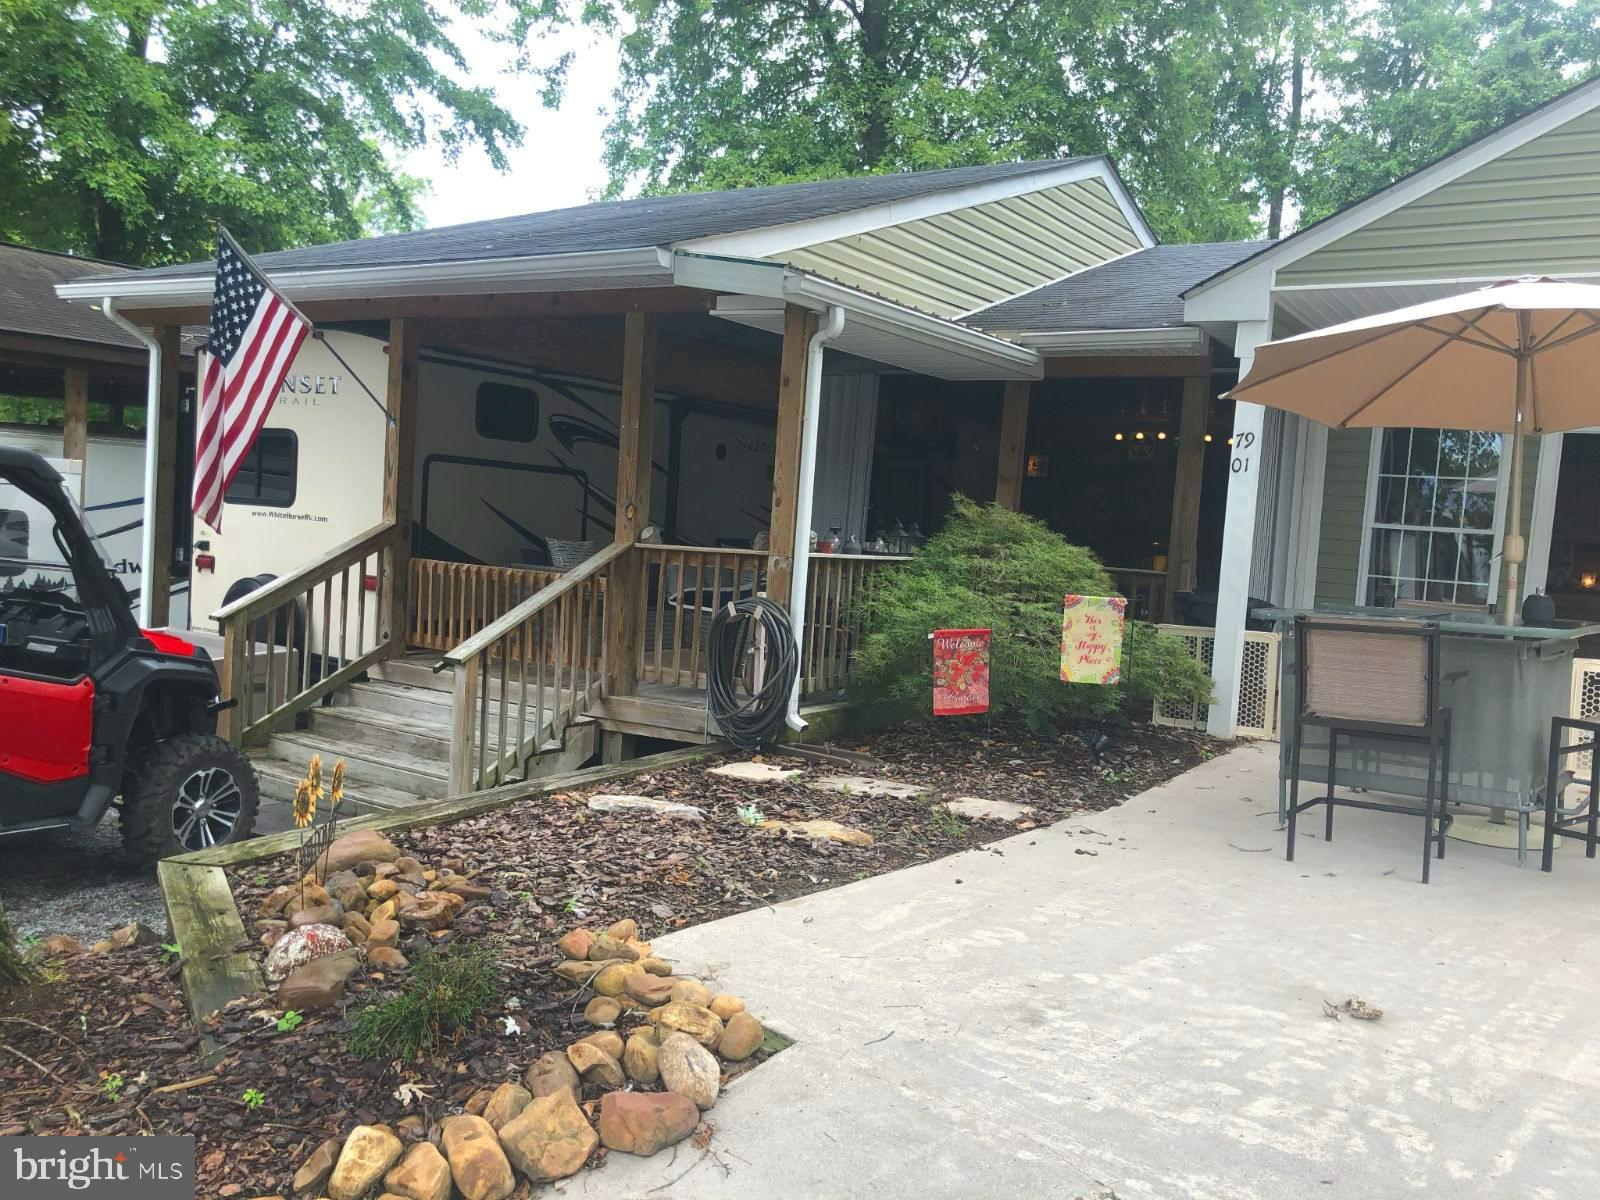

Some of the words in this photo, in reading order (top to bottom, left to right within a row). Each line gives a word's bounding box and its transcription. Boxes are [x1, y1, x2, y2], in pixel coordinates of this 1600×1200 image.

[1235, 432, 1255, 449] 79
[1232, 457, 1249, 473] 01
[251, 511, 329, 523] www.WhiteHorseRV.com
[1084, 613, 1102, 625] This
[937, 637, 986, 651] Welcome
[1075, 641, 1107, 655] Happy
[1078, 655, 1102, 665] Place
[945, 691, 983, 704] Garden
